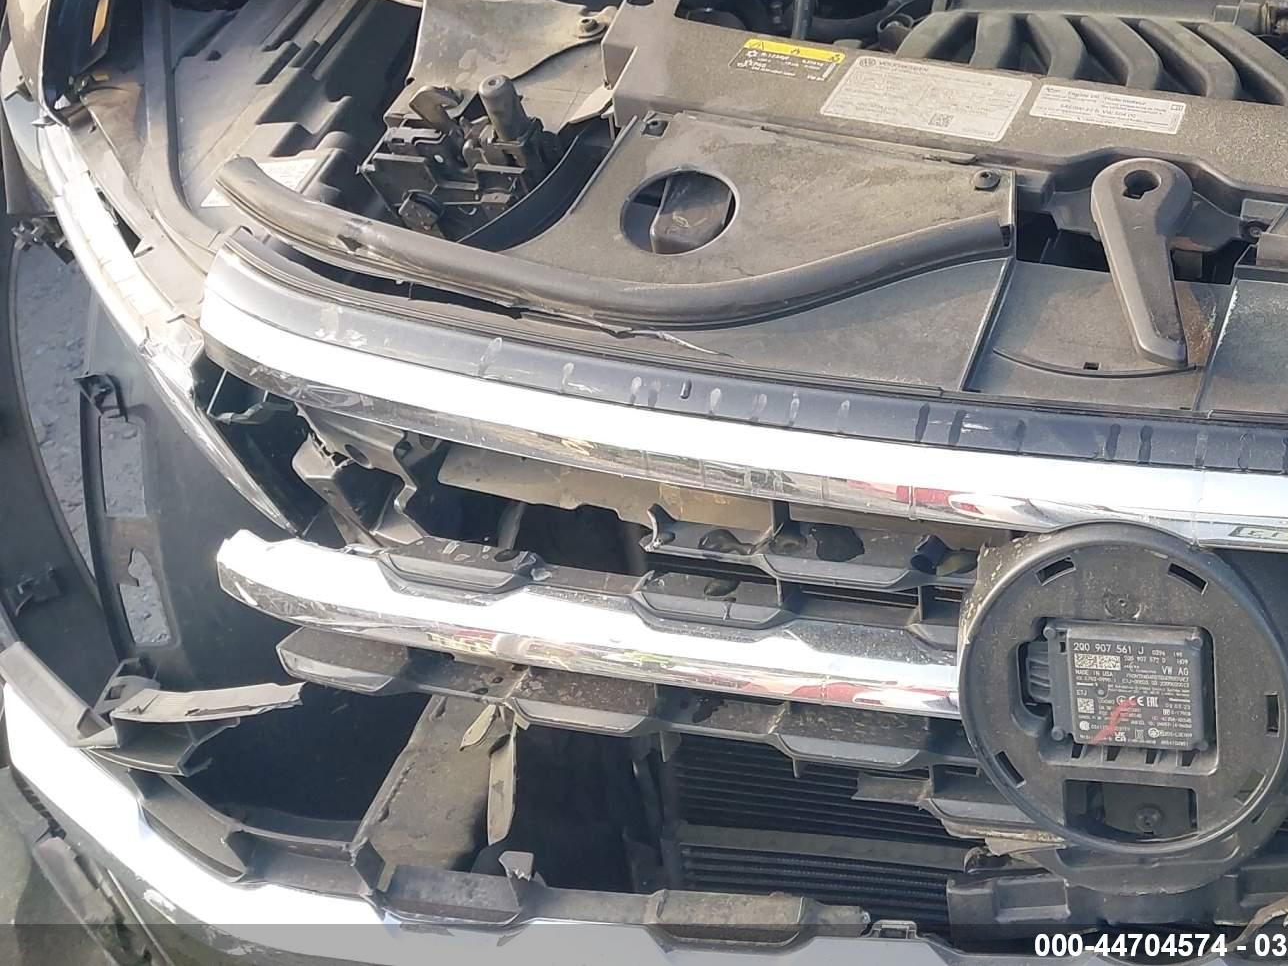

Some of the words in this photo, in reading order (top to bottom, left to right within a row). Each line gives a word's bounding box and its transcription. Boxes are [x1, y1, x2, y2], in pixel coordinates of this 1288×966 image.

[1094, 643, 1111, 653] 907
[1116, 644, 1132, 654] 561
[1137, 645, 1144, 655] J
[1161, 665, 1173, 675] VW
[1177, 667, 1189, 676] AG
